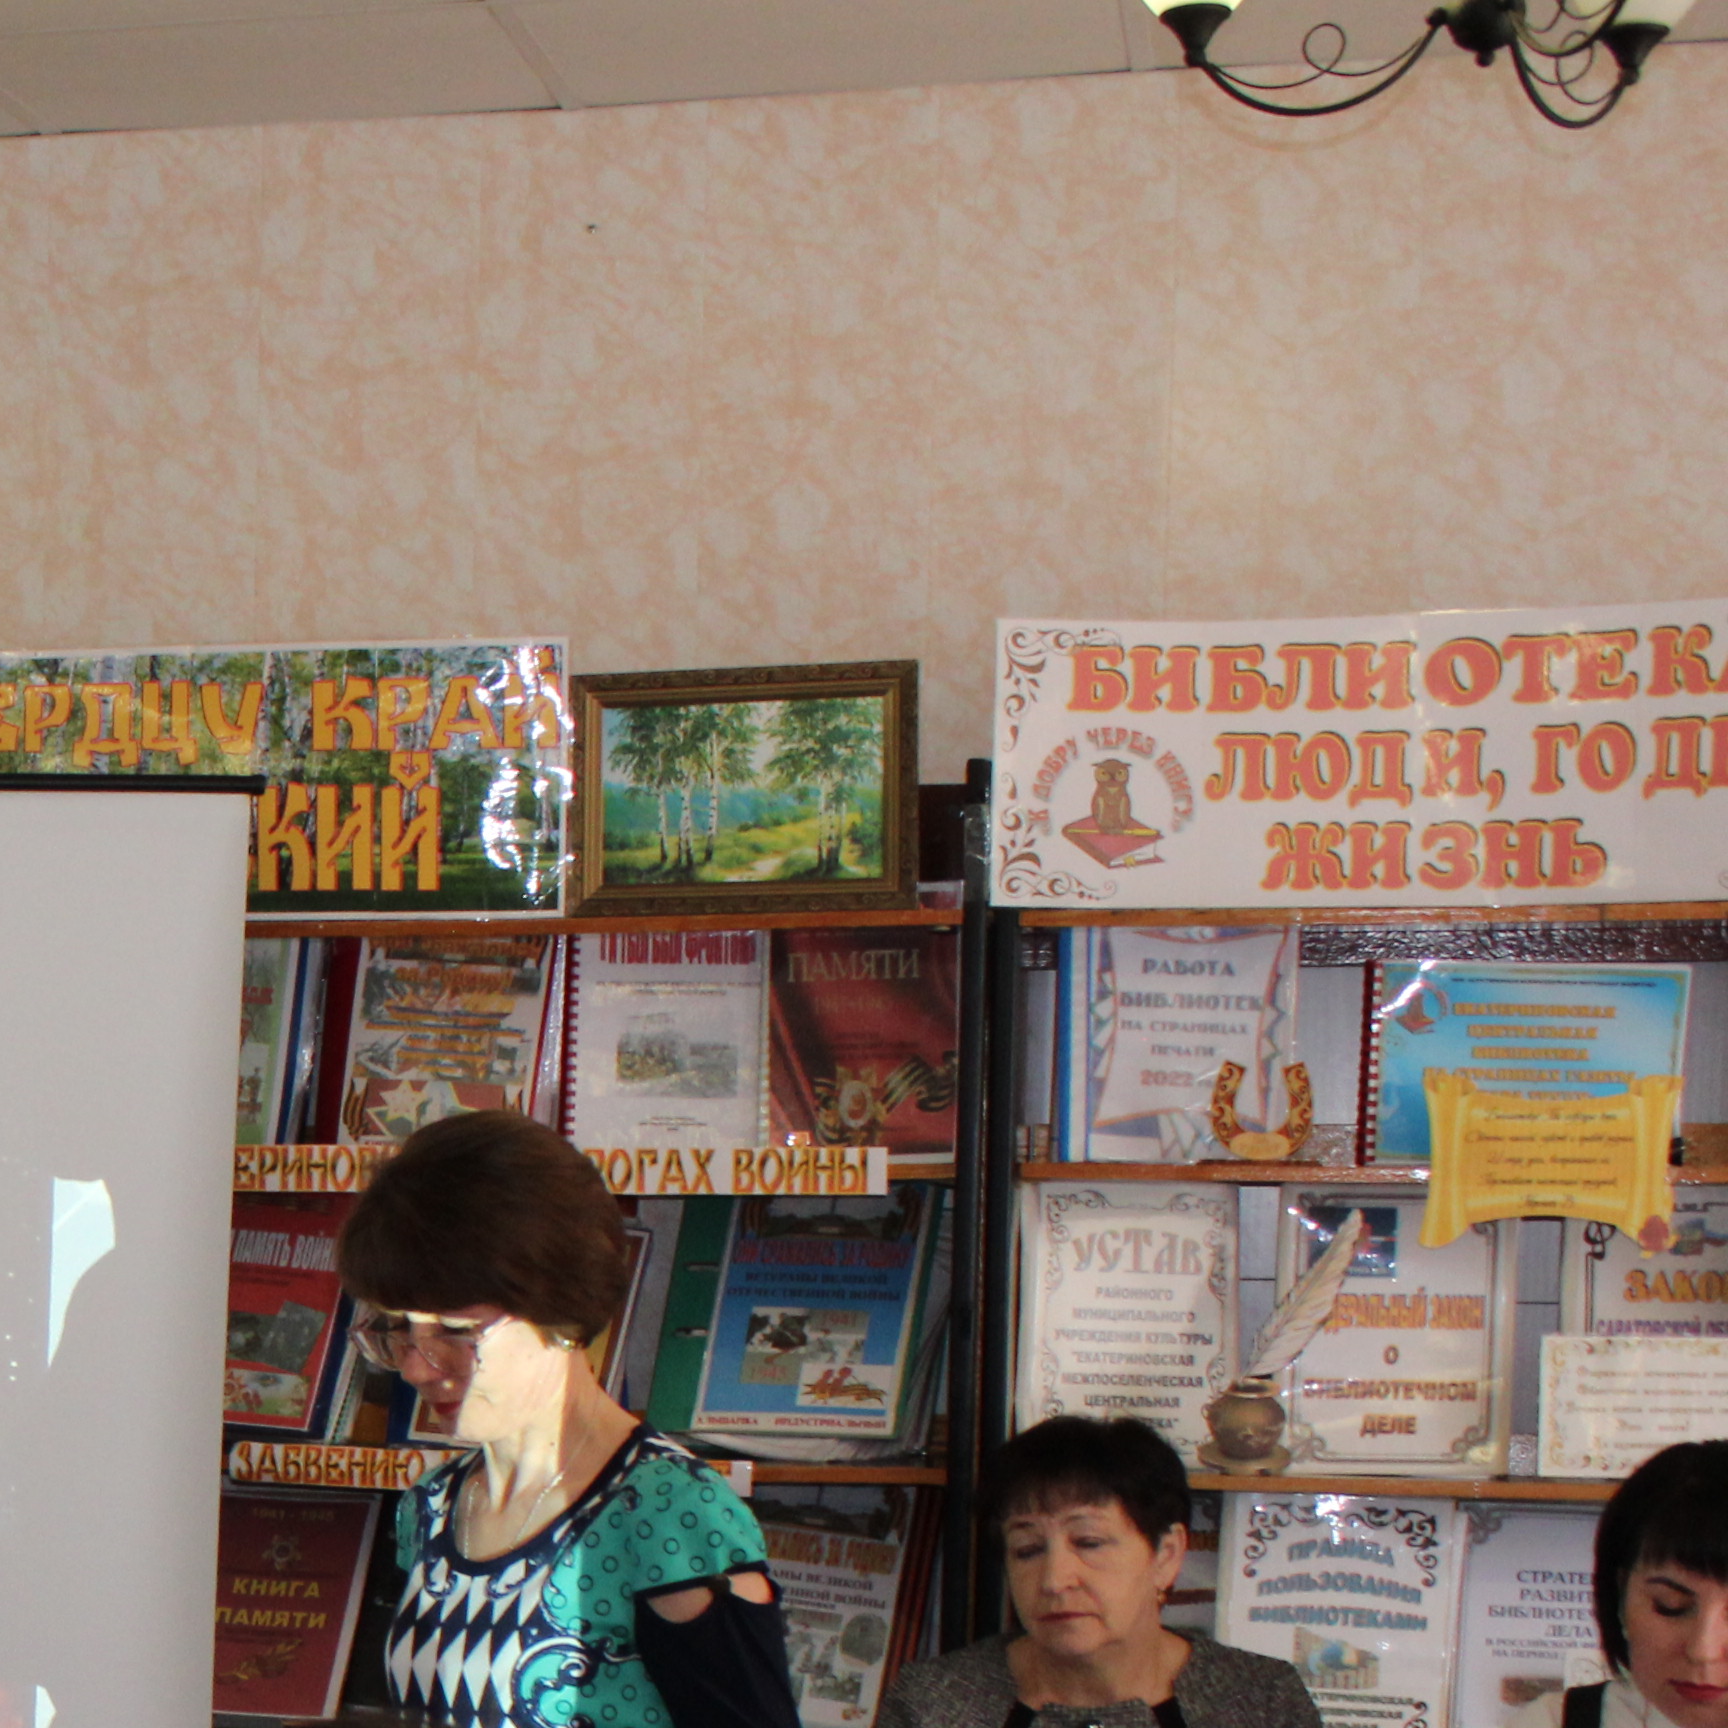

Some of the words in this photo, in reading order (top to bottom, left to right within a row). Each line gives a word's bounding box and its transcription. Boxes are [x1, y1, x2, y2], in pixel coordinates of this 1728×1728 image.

[1066, 622, 1728, 714] БИБЛИОТЕК
[1085, 726, 1156, 758] ЧЕРЕЗ
[1203, 728, 1506, 812] ЛЮДИ,
[248, 752, 442, 893] КИЙ
[1260, 818, 1608, 892] ЖИЗНЬ
[786, 948, 922, 983] ПАМЯТИ
[1142, 957, 1236, 978] РАБОТА
[1140, 1070, 1194, 1087] 2022
[234, 1143, 402, 1192] ЕРИНОВ
[731, 1142, 868, 1195] ВОЙНЫ
[1071, 1227, 1204, 1276] УСТАВ
[1096, 1285, 1174, 1302] РАЙОННОГО
[1623, 1268, 1728, 1304] ЗАКО
[1072, 1307, 1197, 1324] МУНИЦИПАЛЬНОГО
[1054, 1328, 1144, 1345] УЧРЕЖДЕНИЯ
[1145, 1330, 1214, 1346] КУЛЬТУРЫ
[1084, 1394, 1181, 1410] ЦЕНТРАЛЬНАЯ
[1360, 1414, 1417, 1438] ДЕЛЕ
[233, 1440, 426, 1491] ЗАБВЕНИЮ
[1287, 1539, 1395, 1568] ПРАВИЛА
[232, 1576, 321, 1599] КНИГА
[1257, 1572, 1423, 1605] ПОЛЬЗОВАНИЯ
[1519, 1587, 1595, 1604] РАЗВИТ
[215, 1605, 328, 1630] ПАМЯТИ
[1248, 1605, 1428, 1632] БИБЛИОТЕКАМИ
[1544, 1624, 1594, 1639] ДЕЛА
